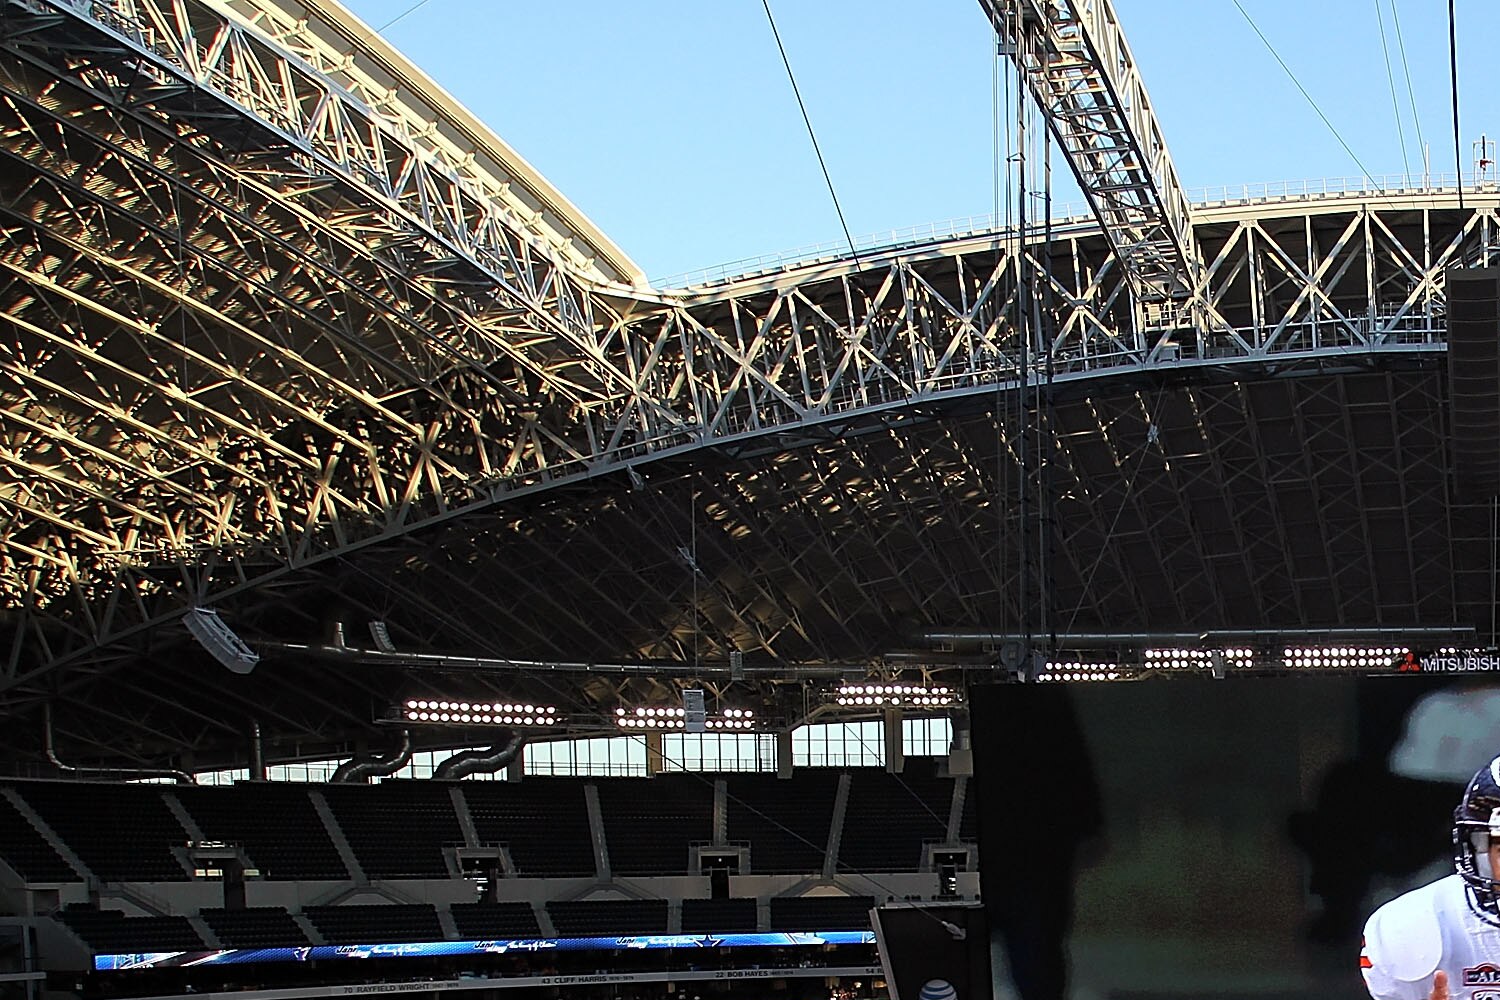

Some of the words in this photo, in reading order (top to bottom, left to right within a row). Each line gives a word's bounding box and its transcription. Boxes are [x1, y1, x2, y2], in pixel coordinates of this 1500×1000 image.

[344, 986, 353, 994] 70
[356, 984, 396, 993] RAYFIELD
[398, 983, 430, 991] WRIGHT
